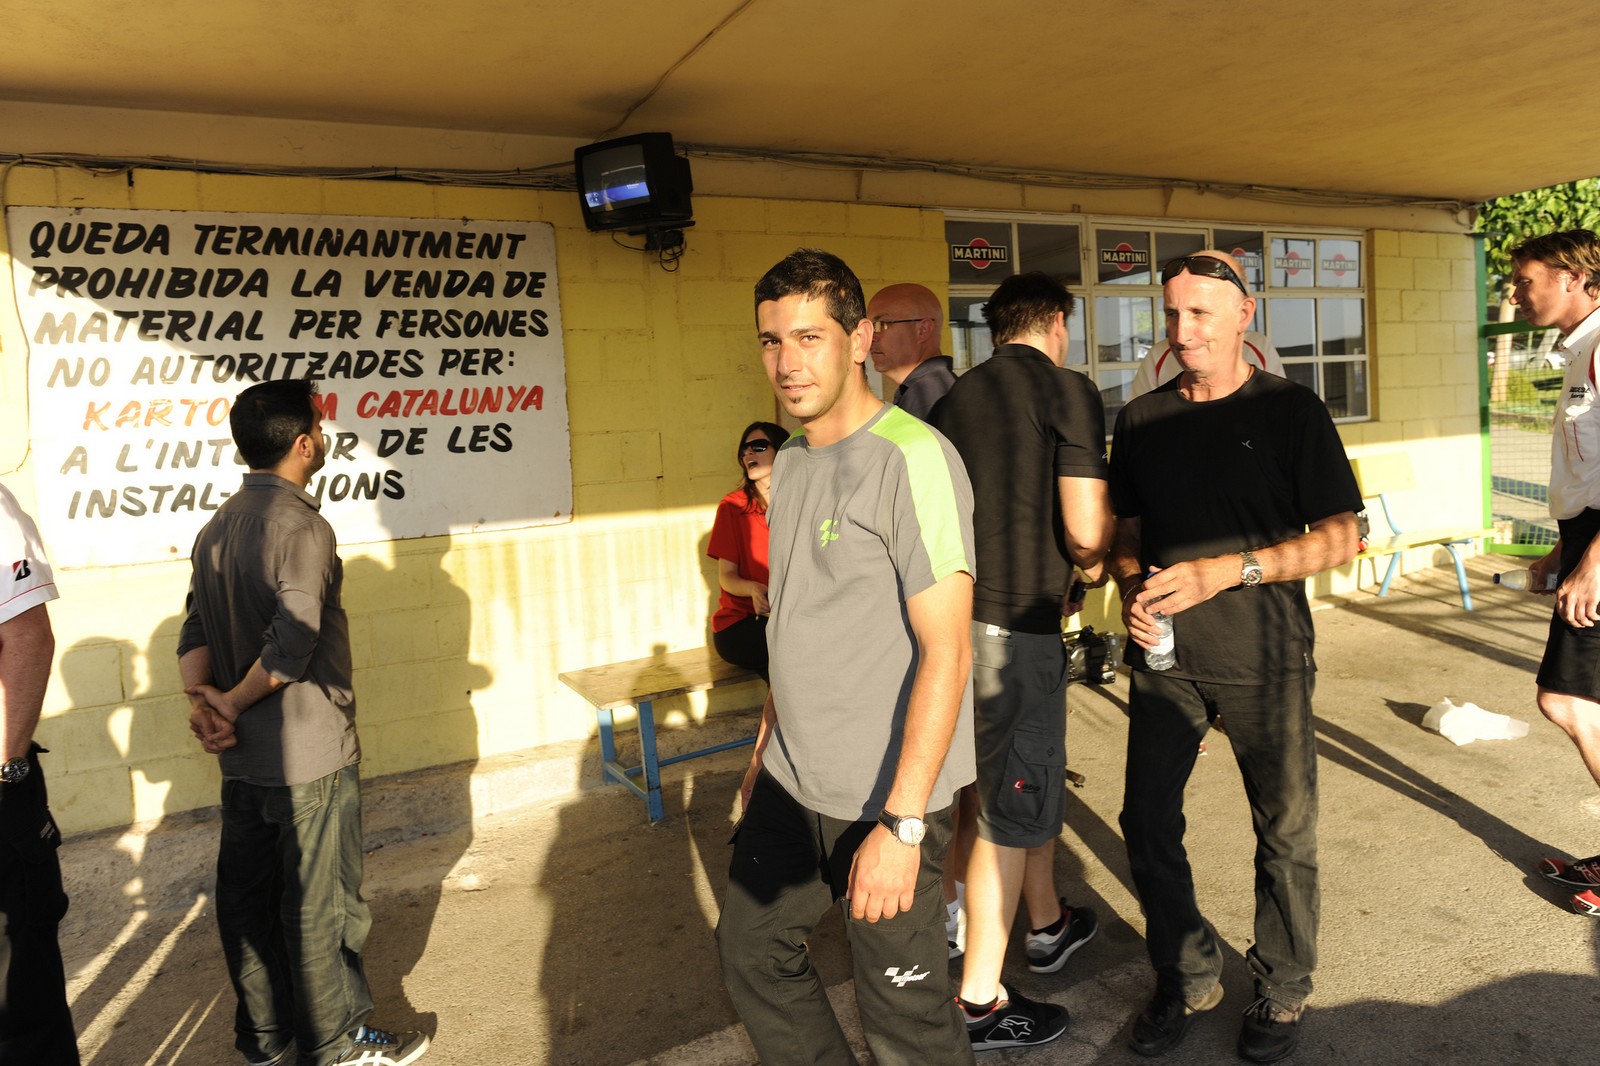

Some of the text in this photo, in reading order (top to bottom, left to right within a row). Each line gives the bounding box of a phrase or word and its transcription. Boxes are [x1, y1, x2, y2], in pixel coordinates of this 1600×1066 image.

[29, 221, 526, 260] QUEDA TERMINANTMENT
[954, 246, 1005, 261] MARTINI
[1103, 251, 1146, 263] MARTINI
[1274, 258, 1310, 269] MARTINI
[1322, 260, 1357, 270] MARTINI
[28, 266, 547, 299] PROHIBIDA LA VENDA DE
[33, 310, 264, 344] MATERIAL
[289, 309, 362, 339] PER
[47, 348, 514, 388] NO AUTORITZADES PER:
[356, 385, 544, 419] CATALUNYA
[59, 446, 88, 475] A
[377, 427, 428, 458] DE
[447, 422, 513, 454] LES
